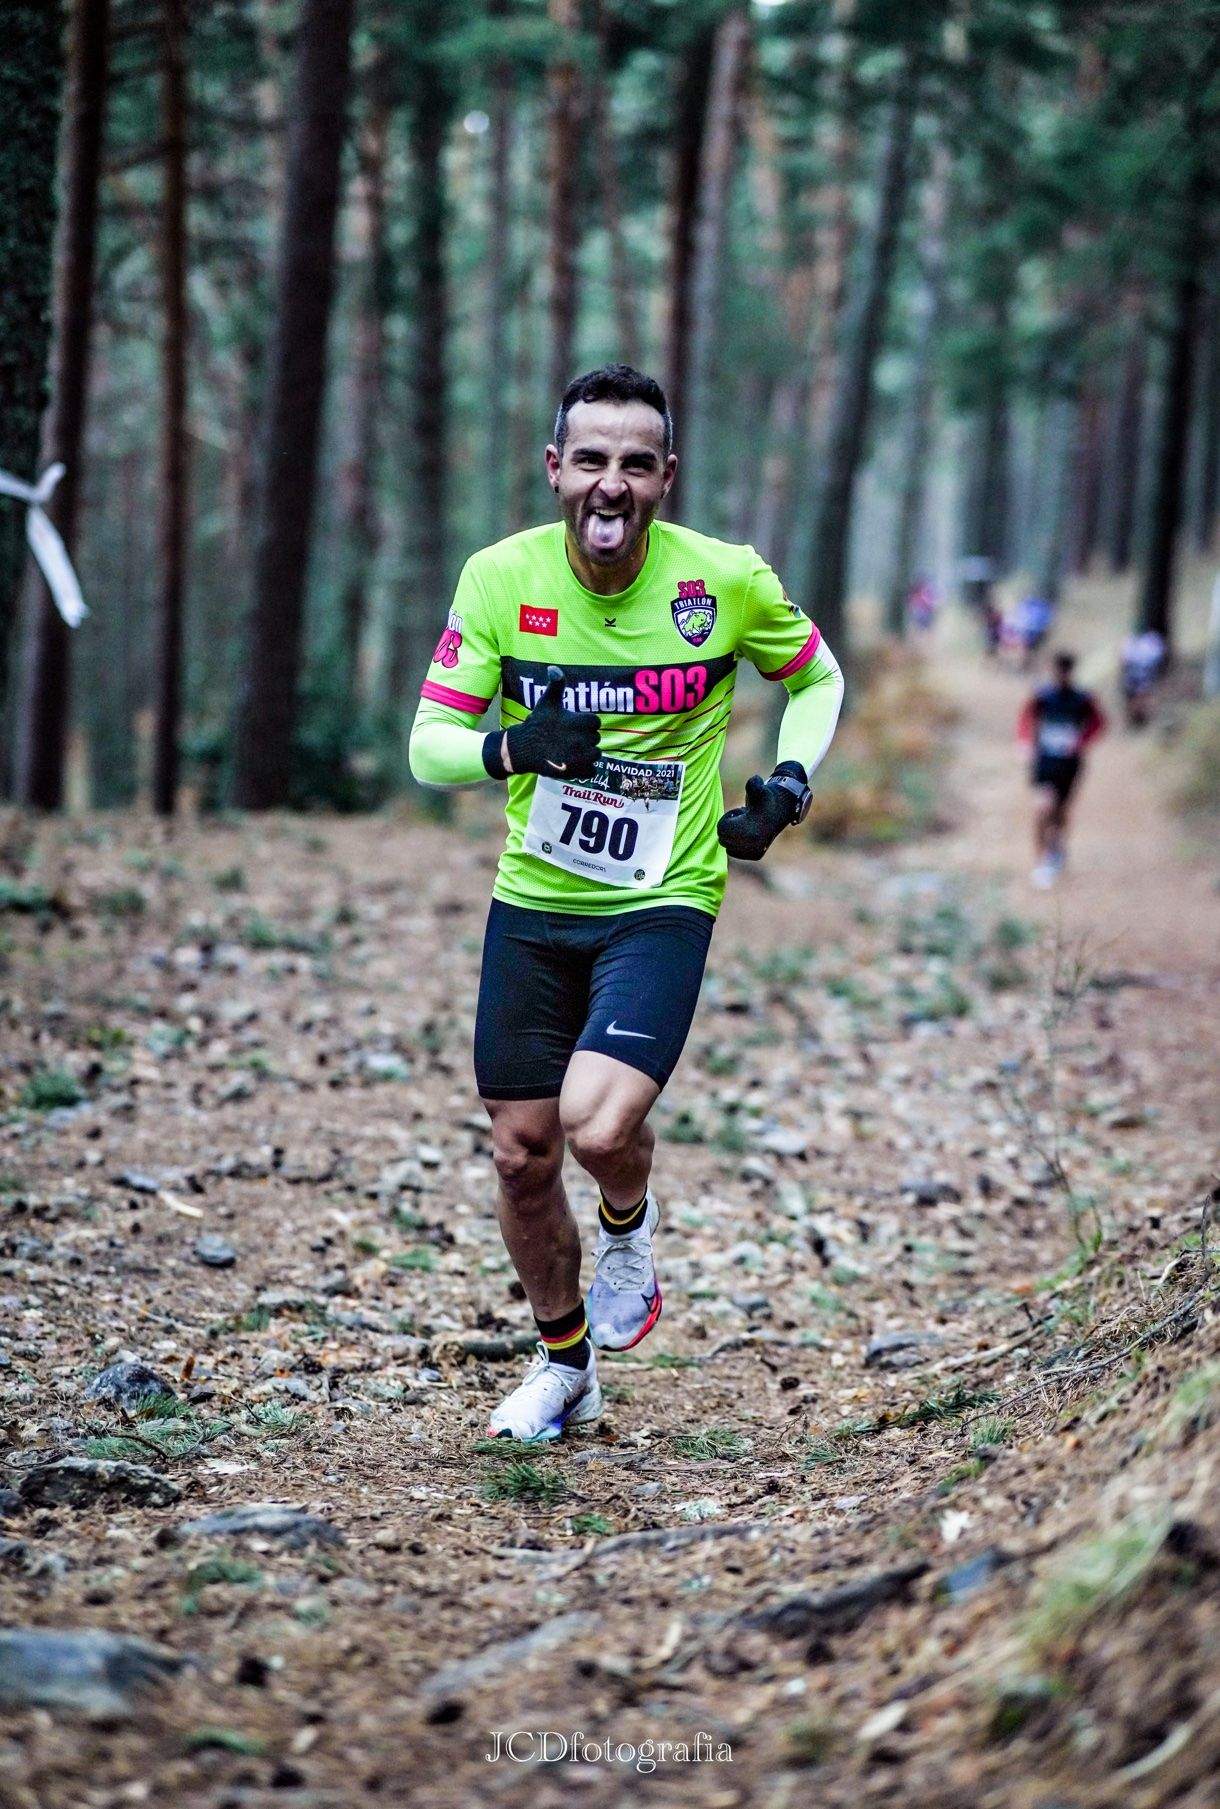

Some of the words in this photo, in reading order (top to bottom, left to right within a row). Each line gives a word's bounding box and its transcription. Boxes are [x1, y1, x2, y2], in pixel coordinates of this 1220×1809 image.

[520, 675, 634, 713] Tratlón
[606, 762, 653, 777] NAVIDAD
[655, 769, 675, 778] 2021
[562, 784, 592, 800] Trail
[591, 790, 625, 809] Run
[559, 802, 639, 861] 790
